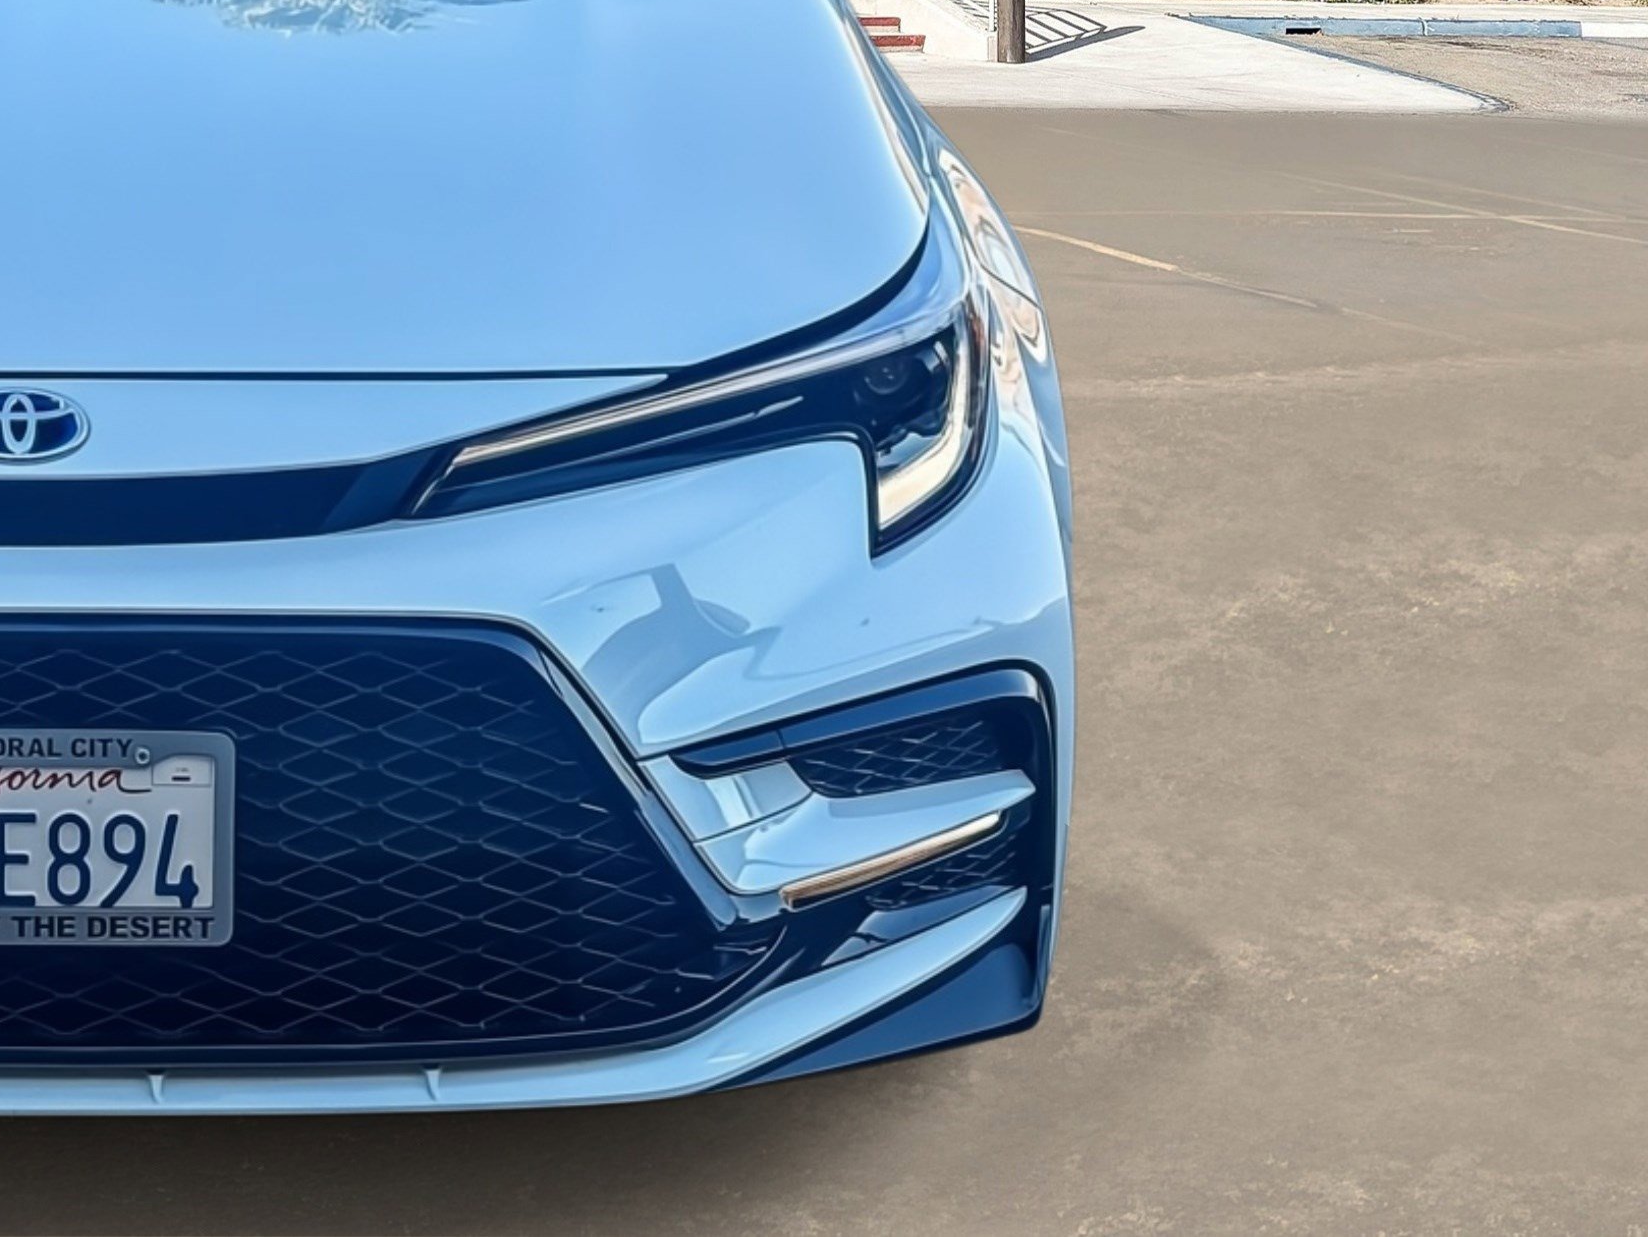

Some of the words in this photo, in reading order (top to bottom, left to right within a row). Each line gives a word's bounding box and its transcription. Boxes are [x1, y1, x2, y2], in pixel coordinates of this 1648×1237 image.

[70, 737, 133, 759] CITY
[12, 916, 76, 939] THE
[86, 916, 214, 939] DESERT
